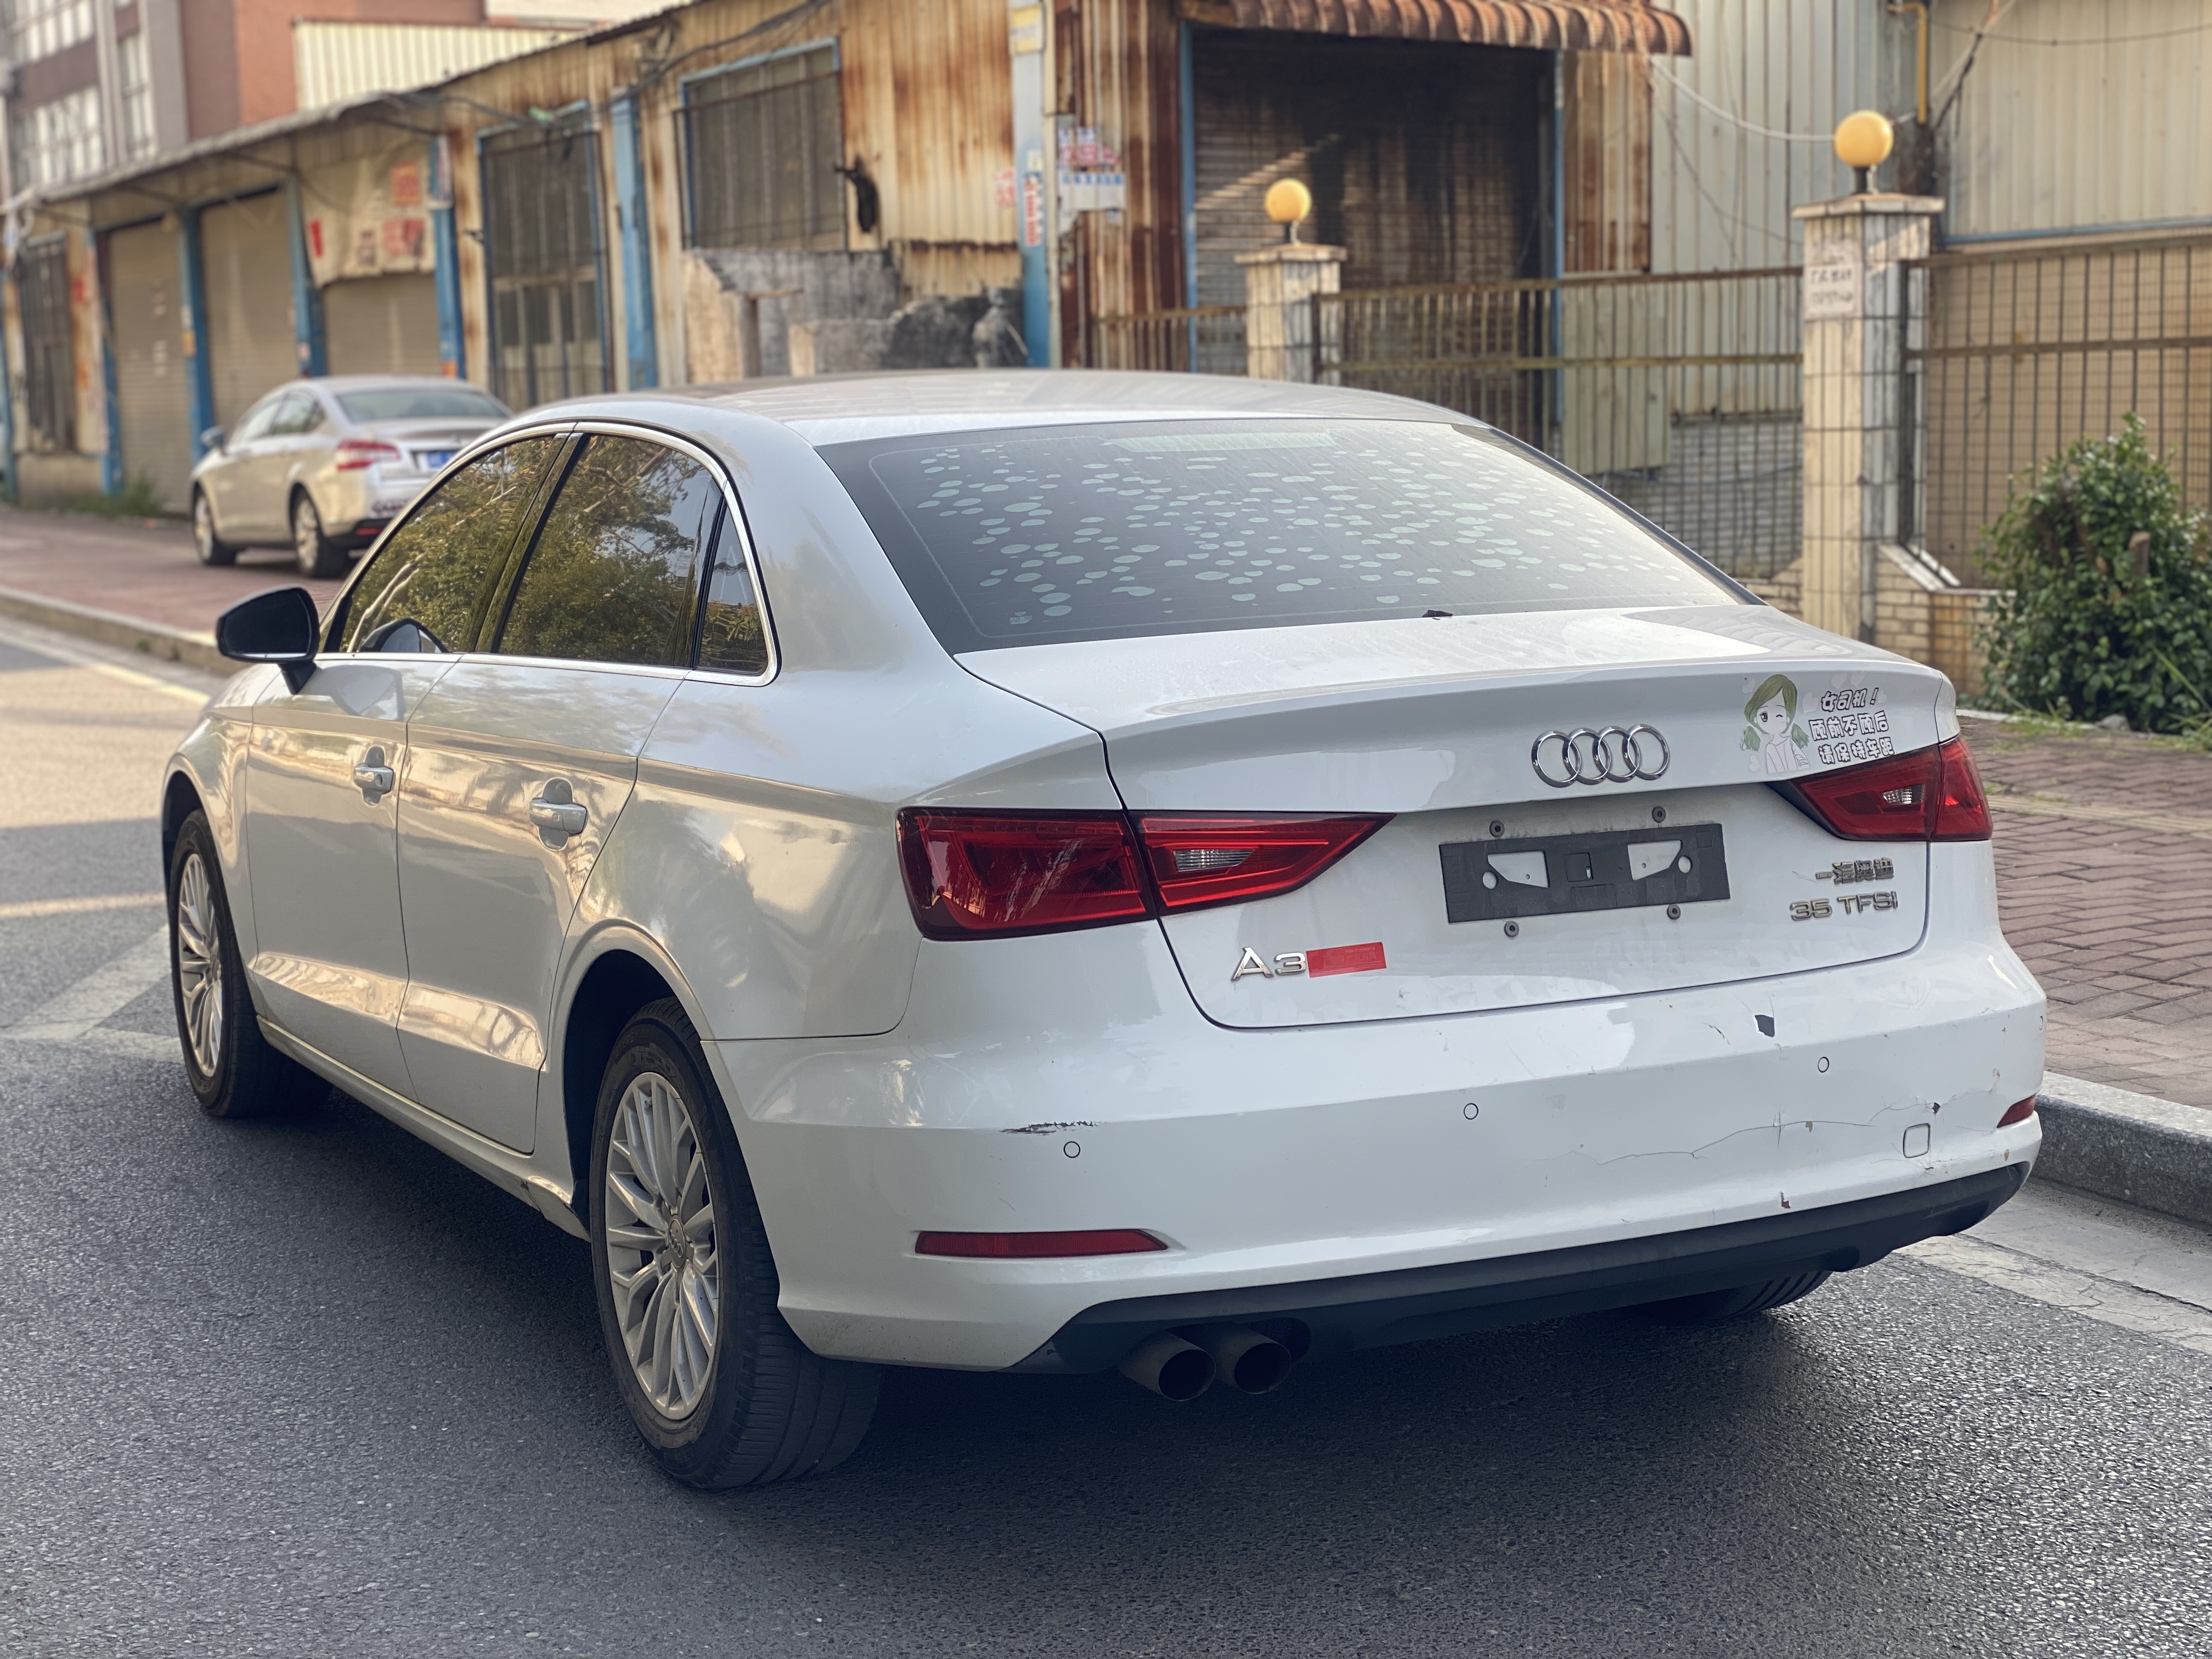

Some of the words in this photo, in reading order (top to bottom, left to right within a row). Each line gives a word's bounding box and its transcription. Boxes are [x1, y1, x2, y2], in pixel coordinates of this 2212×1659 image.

[1809, 710, 1889, 741] 顾前不顾后
[1818, 737, 1894, 764] 请保持车距
[1815, 857, 1894, 884] 一汽奥迪
[1790, 898, 1833, 921] 35
[1837, 891, 1898, 915] TFSI
[1231, 947, 1306, 981] A3
